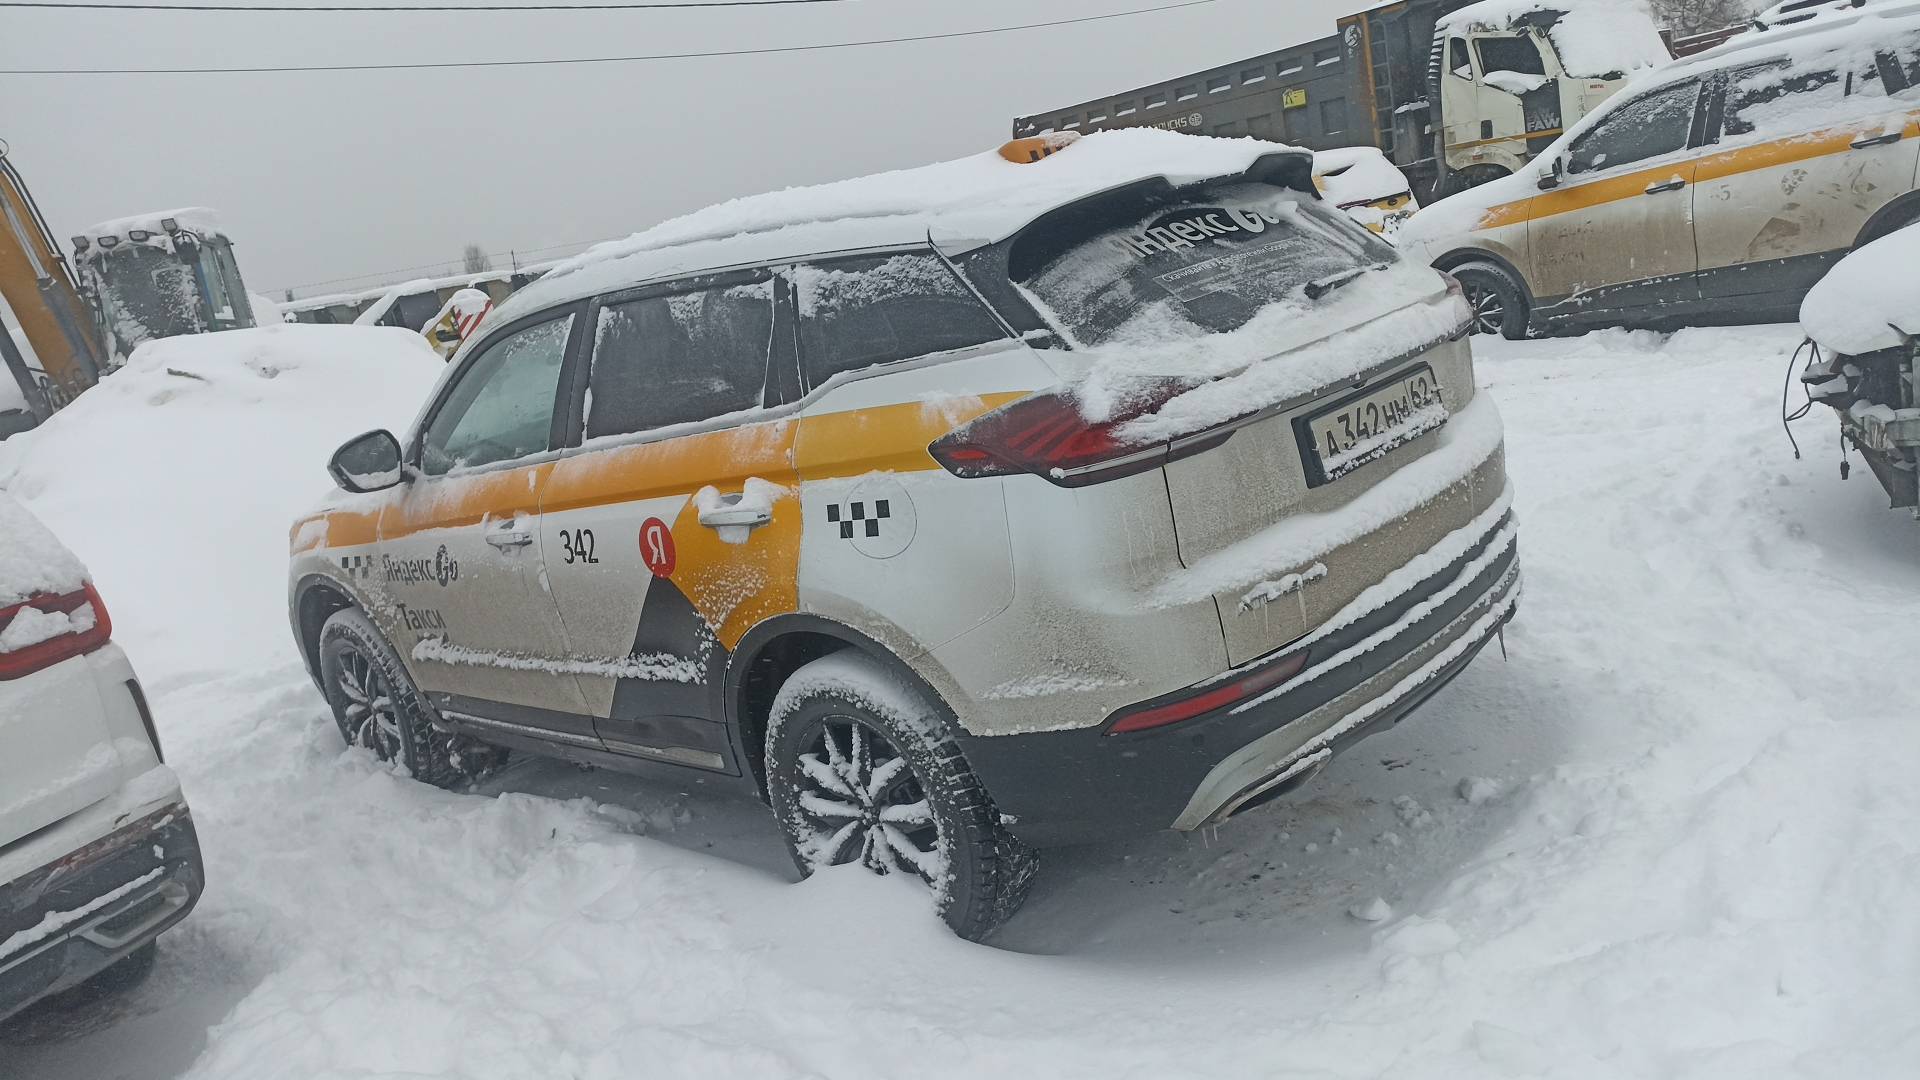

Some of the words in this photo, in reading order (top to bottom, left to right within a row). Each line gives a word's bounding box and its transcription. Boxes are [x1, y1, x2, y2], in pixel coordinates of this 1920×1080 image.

[1528, 117, 1560, 131] FAW
[1410, 377, 1432, 408] 62
[560, 529, 599, 564] 342
[646, 525, 667, 565] Я
[383, 553, 435, 586] Яндекс
[436, 544, 458, 587] Go
[397, 603, 447, 631] Такси
